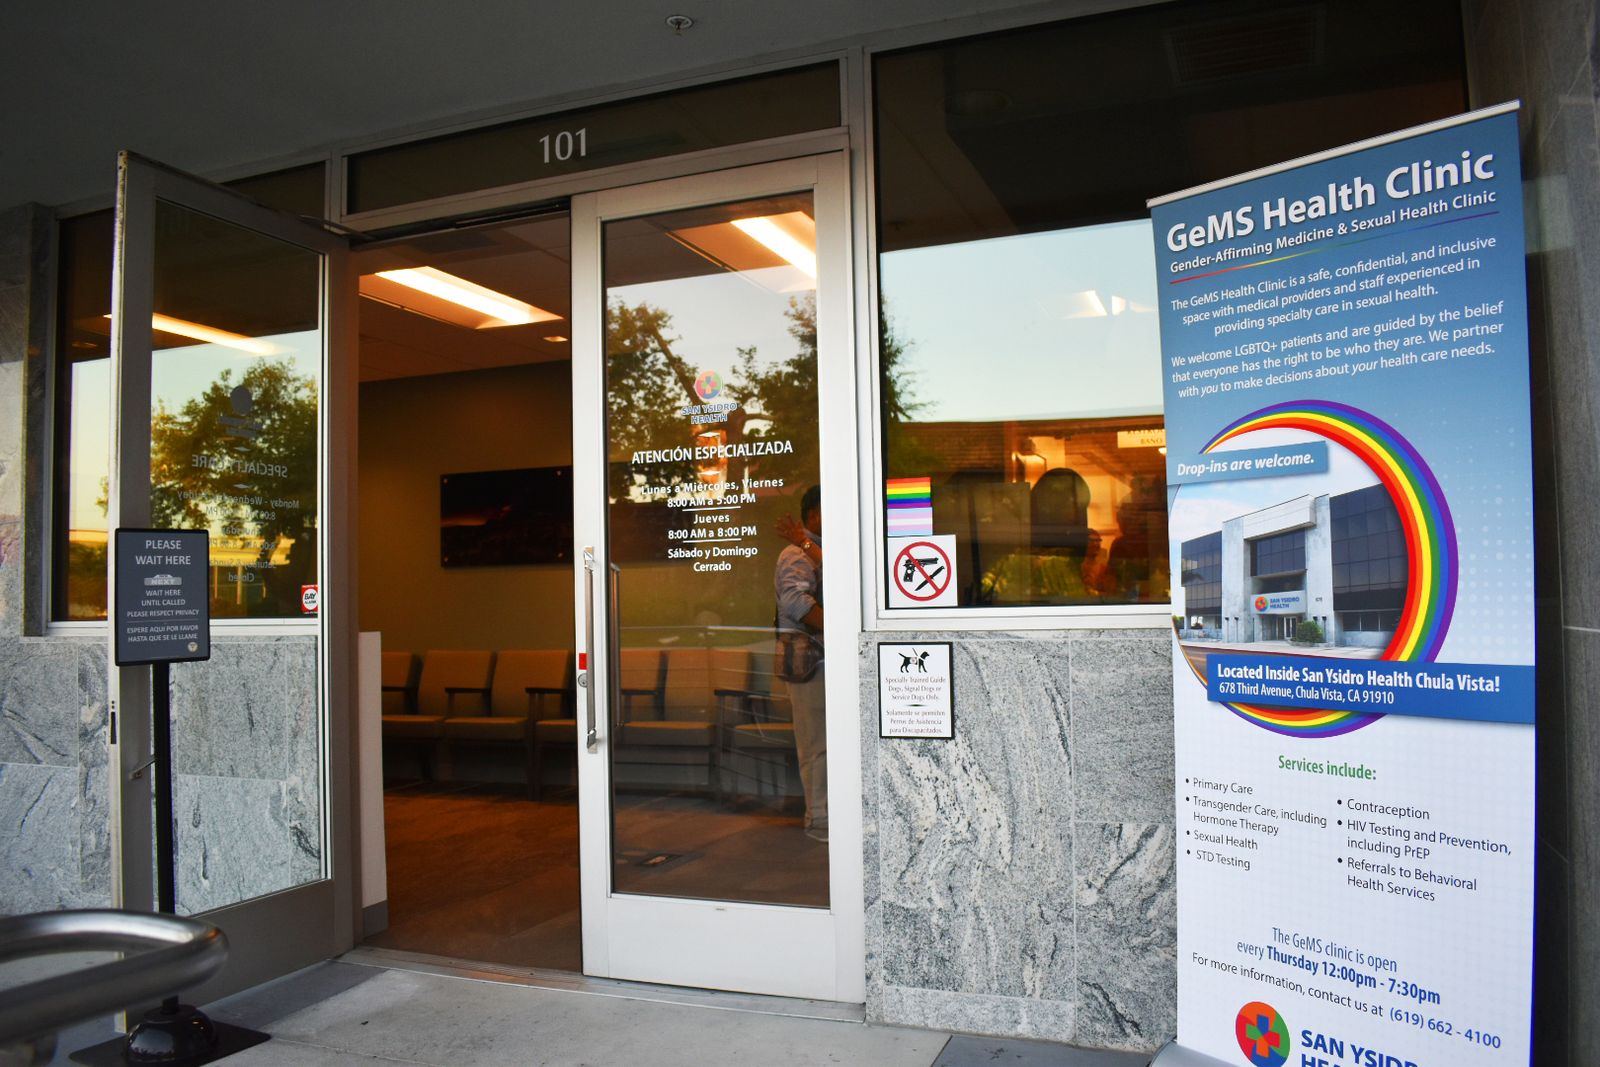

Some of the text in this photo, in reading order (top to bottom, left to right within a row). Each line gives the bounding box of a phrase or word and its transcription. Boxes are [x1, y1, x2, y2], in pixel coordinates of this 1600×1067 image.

[538, 128, 586, 164] 101
[1167, 151, 1493, 251] GeMS Health Clinic
[1170, 192, 1495, 272] Gender-Affirming Medicine Sexual Health Clinic
[1170, 237, 1495, 310] The GeMS Health Clinic safe, confidential, inclusive
[1182, 260, 1463, 325] space with medical providers staff experienced
[1214, 284, 1438, 336] providing specialty care sexual health.
[1187, 300, 1503, 364] welcome LGBTQ+ patients guided belief
[1172, 323, 1503, 383] that everyone right they are. partner
[1178, 344, 1494, 398] with you make decisions about your health care needs.
[681, 402, 737, 415] SAN YSIDRO
[691, 414, 728, 424] HEALTH
[632, 440, 792, 464] ATENCIÓN ESPECIALIZADA
[1176, 454, 1313, 476] Drop-ins welcome.
[641, 478, 784, 495] Lunes Miércoles, Viernes
[667, 494, 756, 507] 8:00 AM 5:00 PM
[693, 514, 729, 524] Jueves
[145, 539, 181, 549] PLEASE
[668, 525, 756, 539] 8:00 AM 8:00 PM
[135, 555, 190, 564] WAIT HERE
[668, 545, 757, 558] Sábado Domingo
[693, 560, 731, 571] Cerrado
[1218, 663, 1499, 692] Located Inside San Ysidro Health Chula Vista!
[1219, 682, 1393, 704] 678 Third Avenue, Chula Vista, CA 91910
[1278, 755, 1376, 780] Services include:
[1193, 777, 1252, 794] Primary Care
[1193, 796, 1326, 828] Transgender Care, including
[1347, 798, 1429, 819] Contraception
[1193, 812, 1278, 836] Hormone Therapy
[1194, 830, 1257, 849] Sexual Health
[1347, 819, 1511, 855] HIV Testing Prevention,
[1347, 839, 1429, 859] including PrEP
[1196, 850, 1250, 870] STD Testing
[1347, 857, 1476, 890] Referrals Behavioral
[1348, 876, 1434, 901] Health Services
[1272, 927, 1396, 972] The GeMS clinic open
[1211, 960, 1351, 1007] more information, contact
[1237, 942, 1440, 1004] every Thursday 12:00pm 7:30pm
[1390, 1007, 1500, 1048] (619) 662 4100
[1301, 1030, 1344, 1058] SAN
